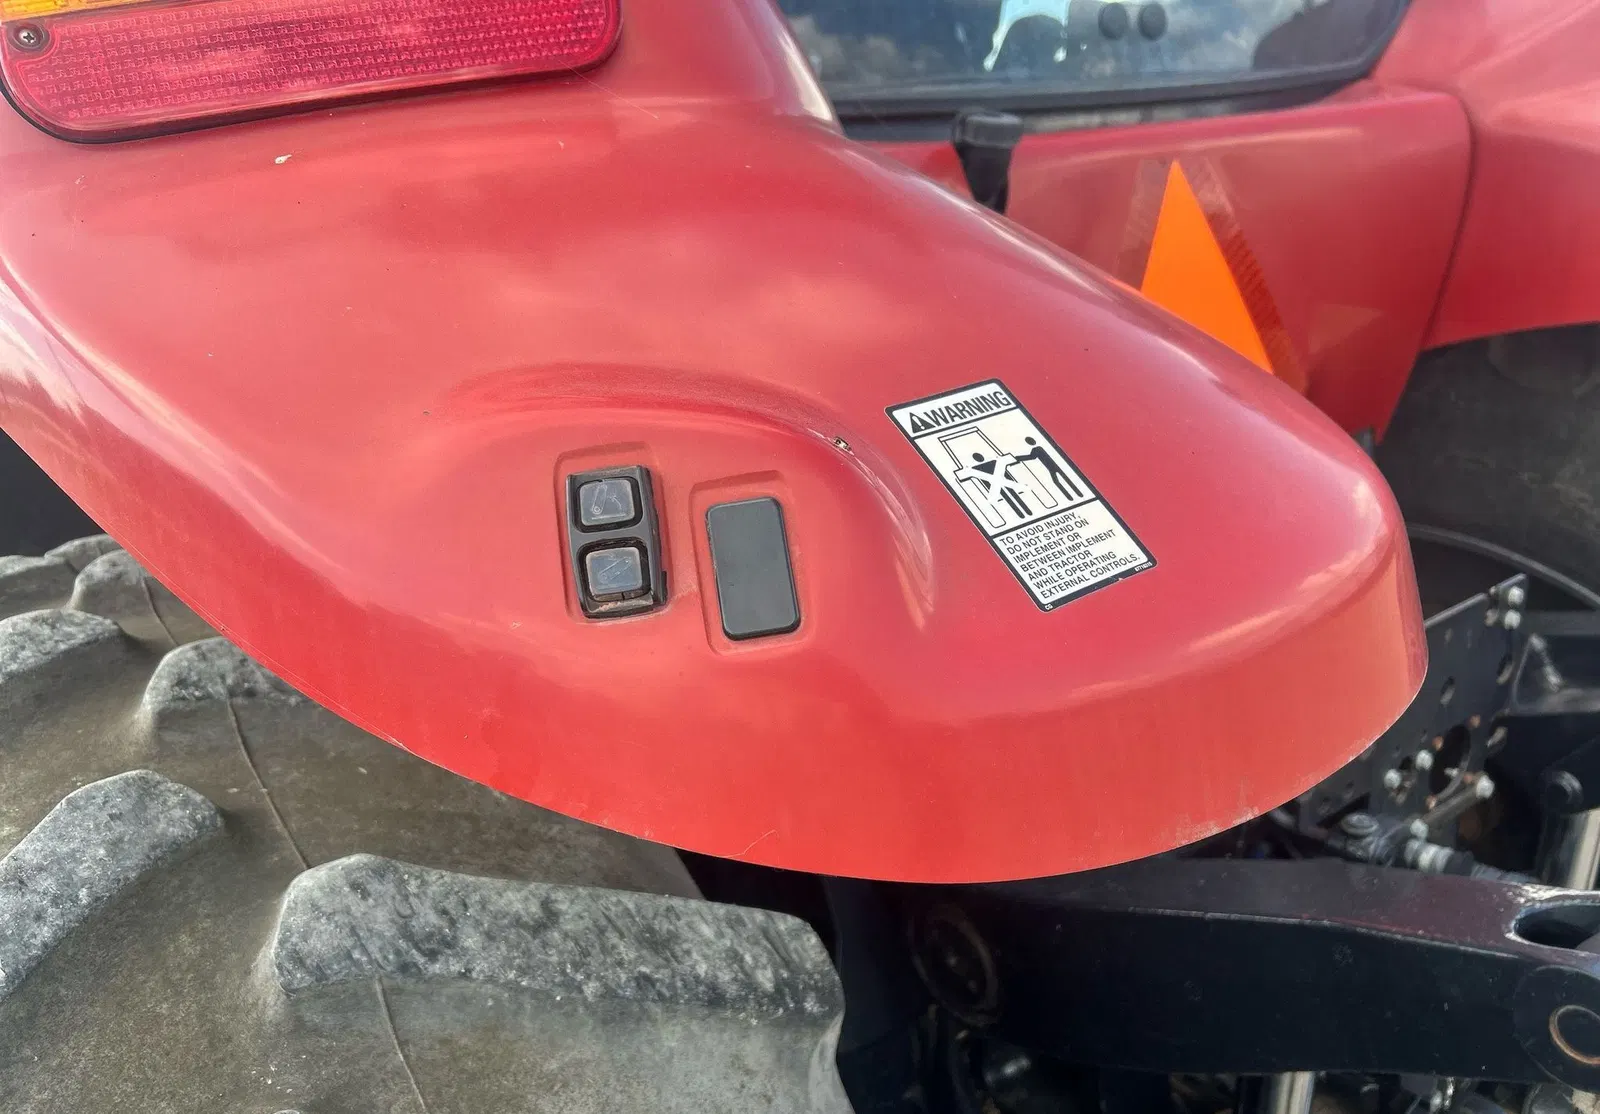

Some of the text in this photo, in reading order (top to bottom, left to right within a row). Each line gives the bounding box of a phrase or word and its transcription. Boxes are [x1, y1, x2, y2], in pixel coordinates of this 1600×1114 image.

[924, 391, 1012, 427] WARNING
[1000, 512, 1081, 546] TO AVOID INJURY,
[1007, 518, 1089, 555] DO NOT STAND ON
[1013, 532, 1082, 564] IMPLEMENT OR
[1020, 529, 1116, 572] BETWEEN IMPLEMENT
[1029, 550, 1092, 581] AND TRACTOR
[1033, 575, 1064, 589] WHILE
[1067, 551, 1116, 577] OPERATING
[1041, 576, 1090, 598] EXTERNAL
[1091, 554, 1140, 578] CONTROLS.
